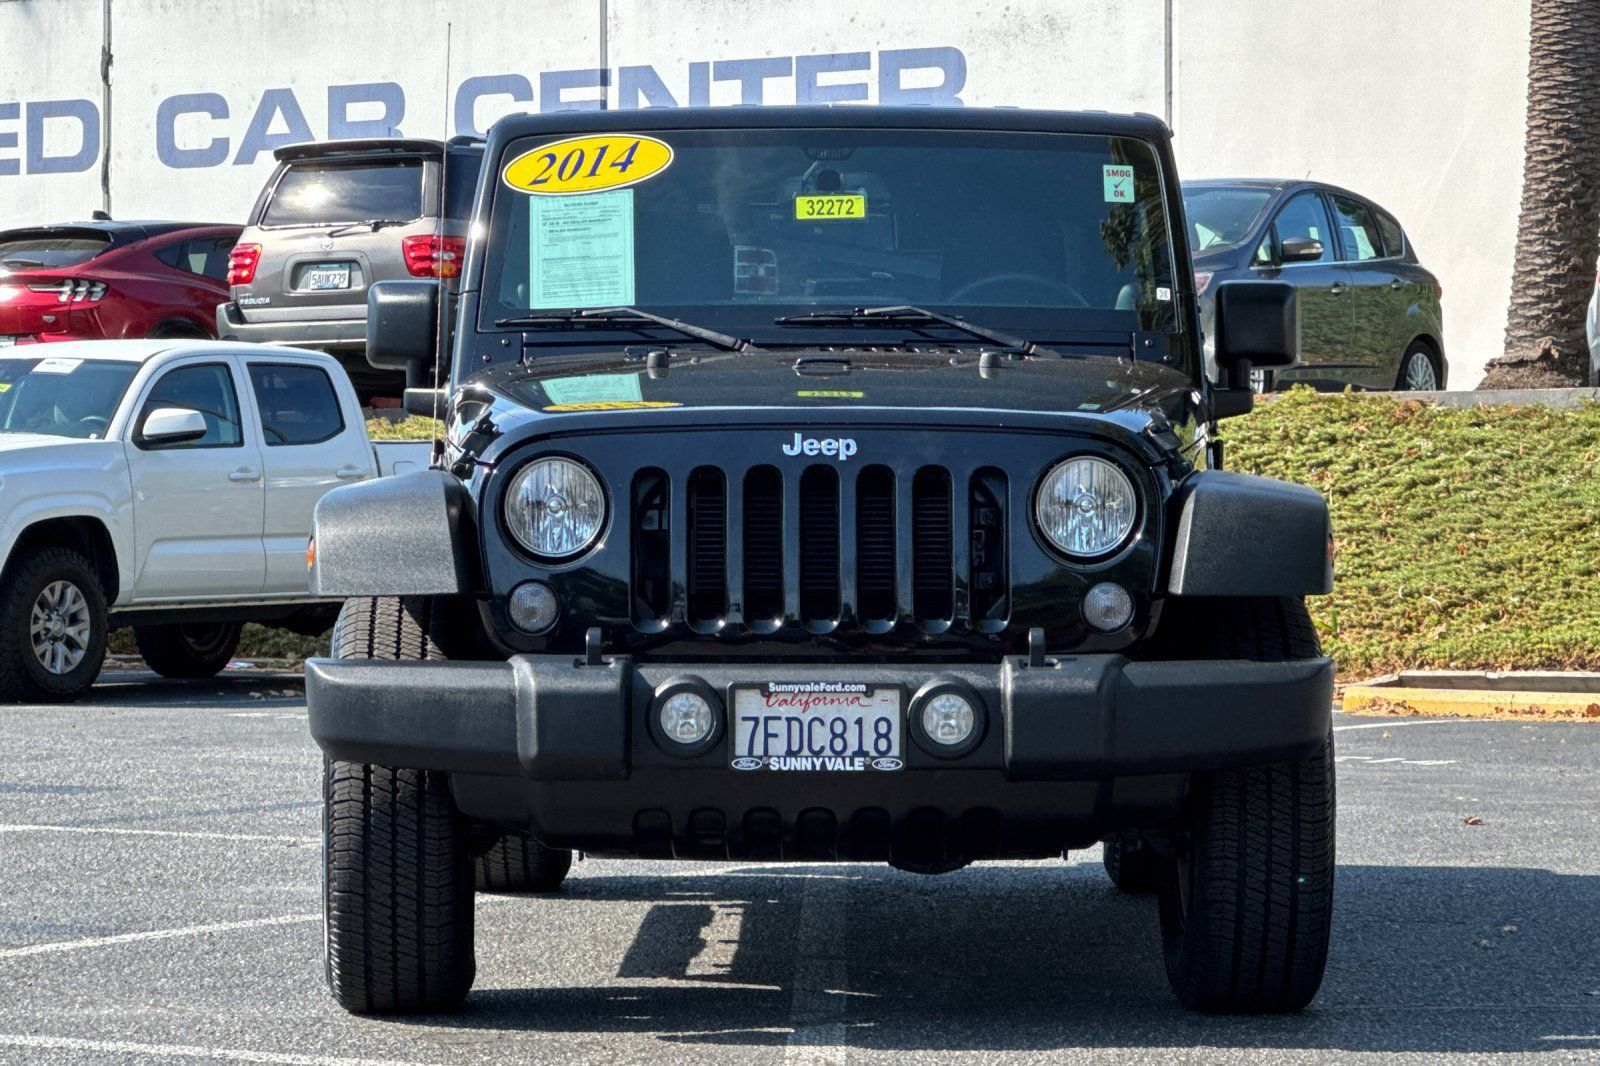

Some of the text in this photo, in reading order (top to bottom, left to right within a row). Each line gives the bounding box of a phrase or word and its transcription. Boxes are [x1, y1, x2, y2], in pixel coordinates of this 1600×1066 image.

[156, 82, 406, 168] CAR
[454, 46, 968, 138] CENTER
[527, 140, 641, 186] 2014
[1105, 169, 1131, 178] SMOG
[1113, 190, 1125, 198] OK
[806, 199, 855, 216] 32272
[239, 297, 270, 305] SEQUOIA
[782, 432, 858, 461] Jeep
[769, 682, 866, 693] SunnyvaleFord.com
[765, 692, 873, 713] California
[741, 716, 893, 757] 7FDC818
[769, 757, 865, 771] SUNNYVALE
